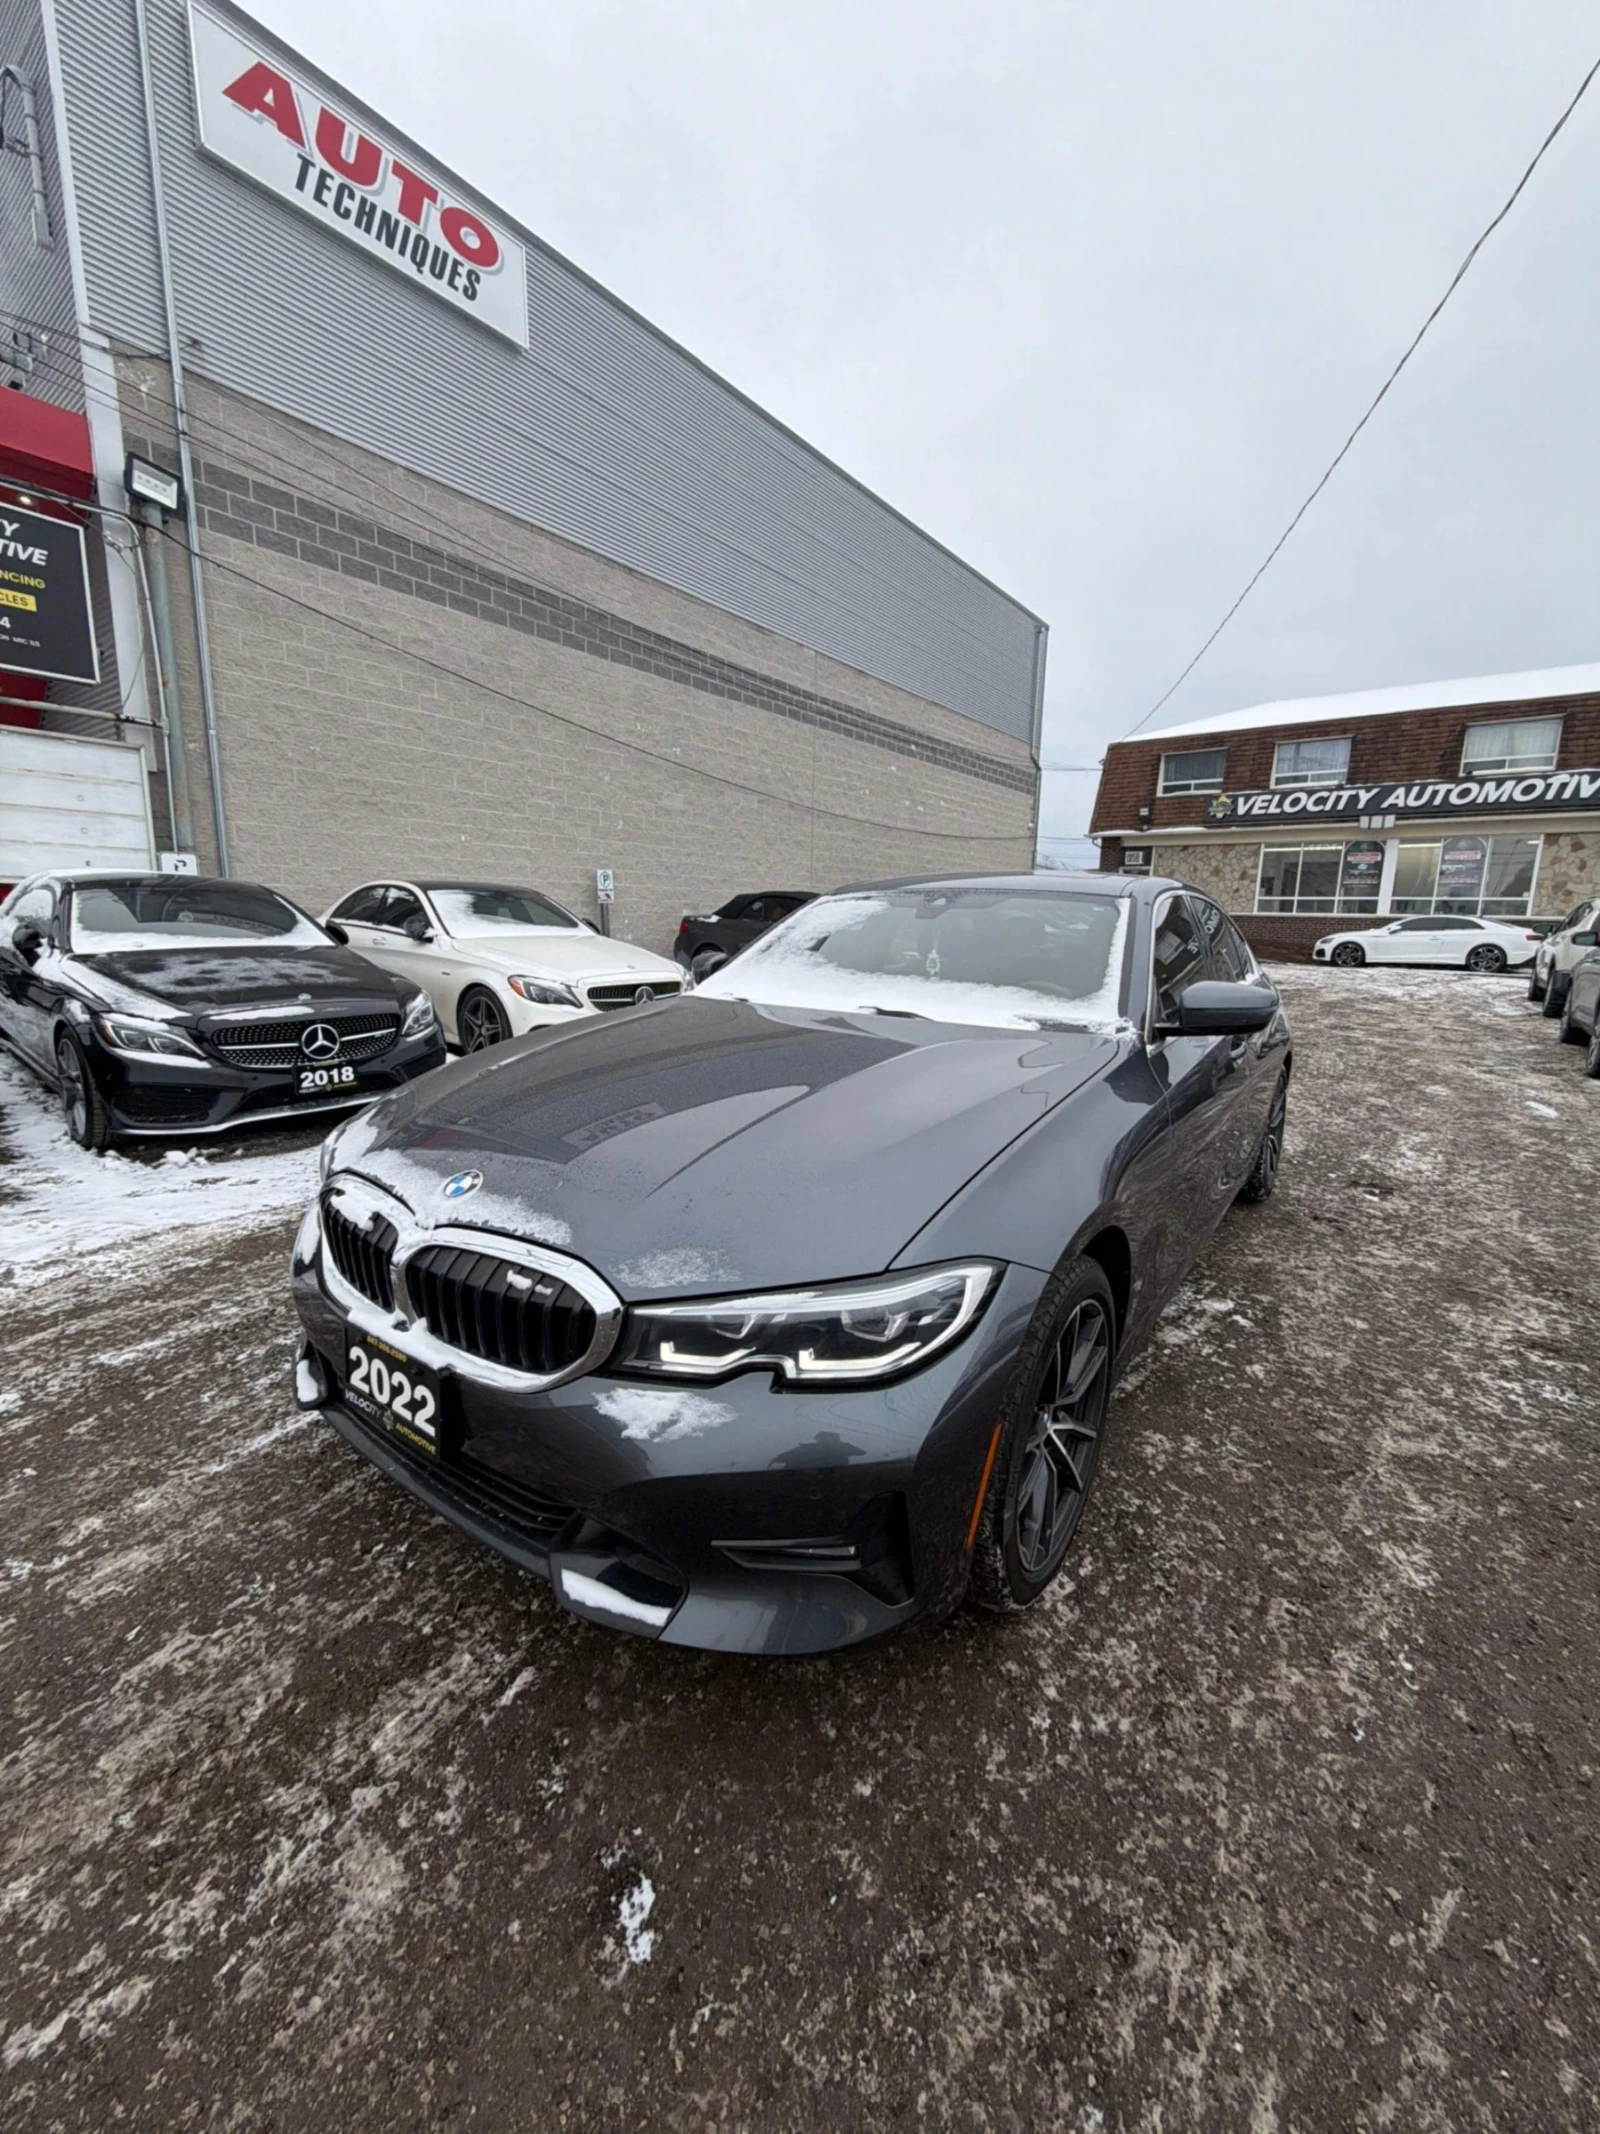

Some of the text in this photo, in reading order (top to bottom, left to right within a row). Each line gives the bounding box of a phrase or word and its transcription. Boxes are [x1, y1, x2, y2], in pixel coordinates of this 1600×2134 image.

[222, 61, 501, 271] AUTO
[295, 153, 481, 301] TECHNIQUES
[1236, 773, 1600, 816] VELOCITY AUTOMOTIV
[299, 1066, 354, 1088] 2018
[344, 1388, 437, 1455] VELOCITY AUTOMOTIVE
[349, 1345, 436, 1438] 2022
